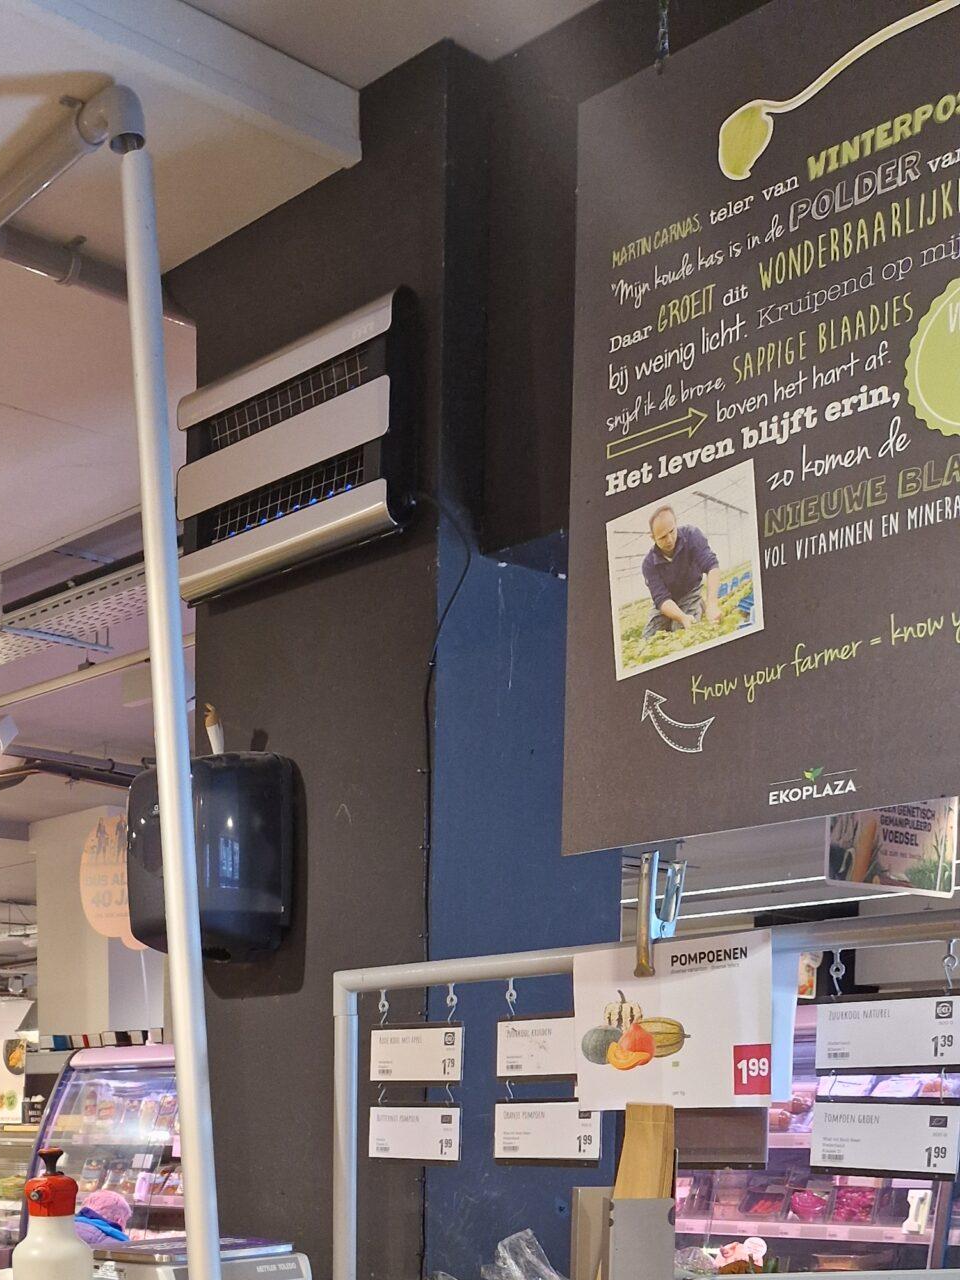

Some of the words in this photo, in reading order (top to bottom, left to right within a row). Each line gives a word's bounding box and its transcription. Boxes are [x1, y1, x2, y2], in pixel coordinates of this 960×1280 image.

[612, 236, 651, 269] MARTIN
[709, 195, 754, 225] teler
[762, 176, 799, 201] van
[654, 252, 694, 289] koude
[697, 246, 725, 271] kas
[729, 240, 742, 258] is
[747, 233, 761, 250] in
[764, 213, 786, 243] de
[789, 150, 921, 232] POLDER
[609, 325, 653, 353] Daar
[657, 283, 717, 333] GROEIT
[722, 284, 749, 307] dit
[758, 179, 960, 291] WONDERBAARLIJK
[606, 395, 642, 435] snijd
[644, 391, 656, 416] ik
[659, 384, 678, 411] de
[680, 377, 727, 403] broze,
[732, 330, 807, 384] SAPPIGE
[818, 292, 913, 353] BLAADJES
[608, 363, 629, 396] bij
[635, 342, 695, 380] weinig
[701, 313, 748, 354] licht.
[756, 266, 876, 329] Kruipend
[882, 256, 913, 282] op
[716, 392, 768, 423] boven
[774, 370, 808, 403] het
[812, 352, 860, 389] hart
[865, 340, 892, 372] af.
[605, 461, 653, 496] Het
[658, 437, 735, 479] leven
[741, 405, 818, 450] blijft
[825, 384, 901, 423] erin,
[766, 468, 795, 491] zo
[801, 443, 872, 481] komen
[878, 416, 912, 458] de
[764, 474, 888, 538] NIEUWE
[764, 543, 787, 569] VOL
[795, 518, 873, 561] VITAMINEN
[881, 511, 900, 538] EN
[691, 673, 738, 704] Know
[743, 662, 788, 703] your
[790, 642, 863, 677] farmer
[890, 613, 944, 646] know
[768, 779, 857, 805] EKOPLAZA
[882, 828, 919, 847] VOEDSEL
[670, 946, 748, 967] POMPOENEN
